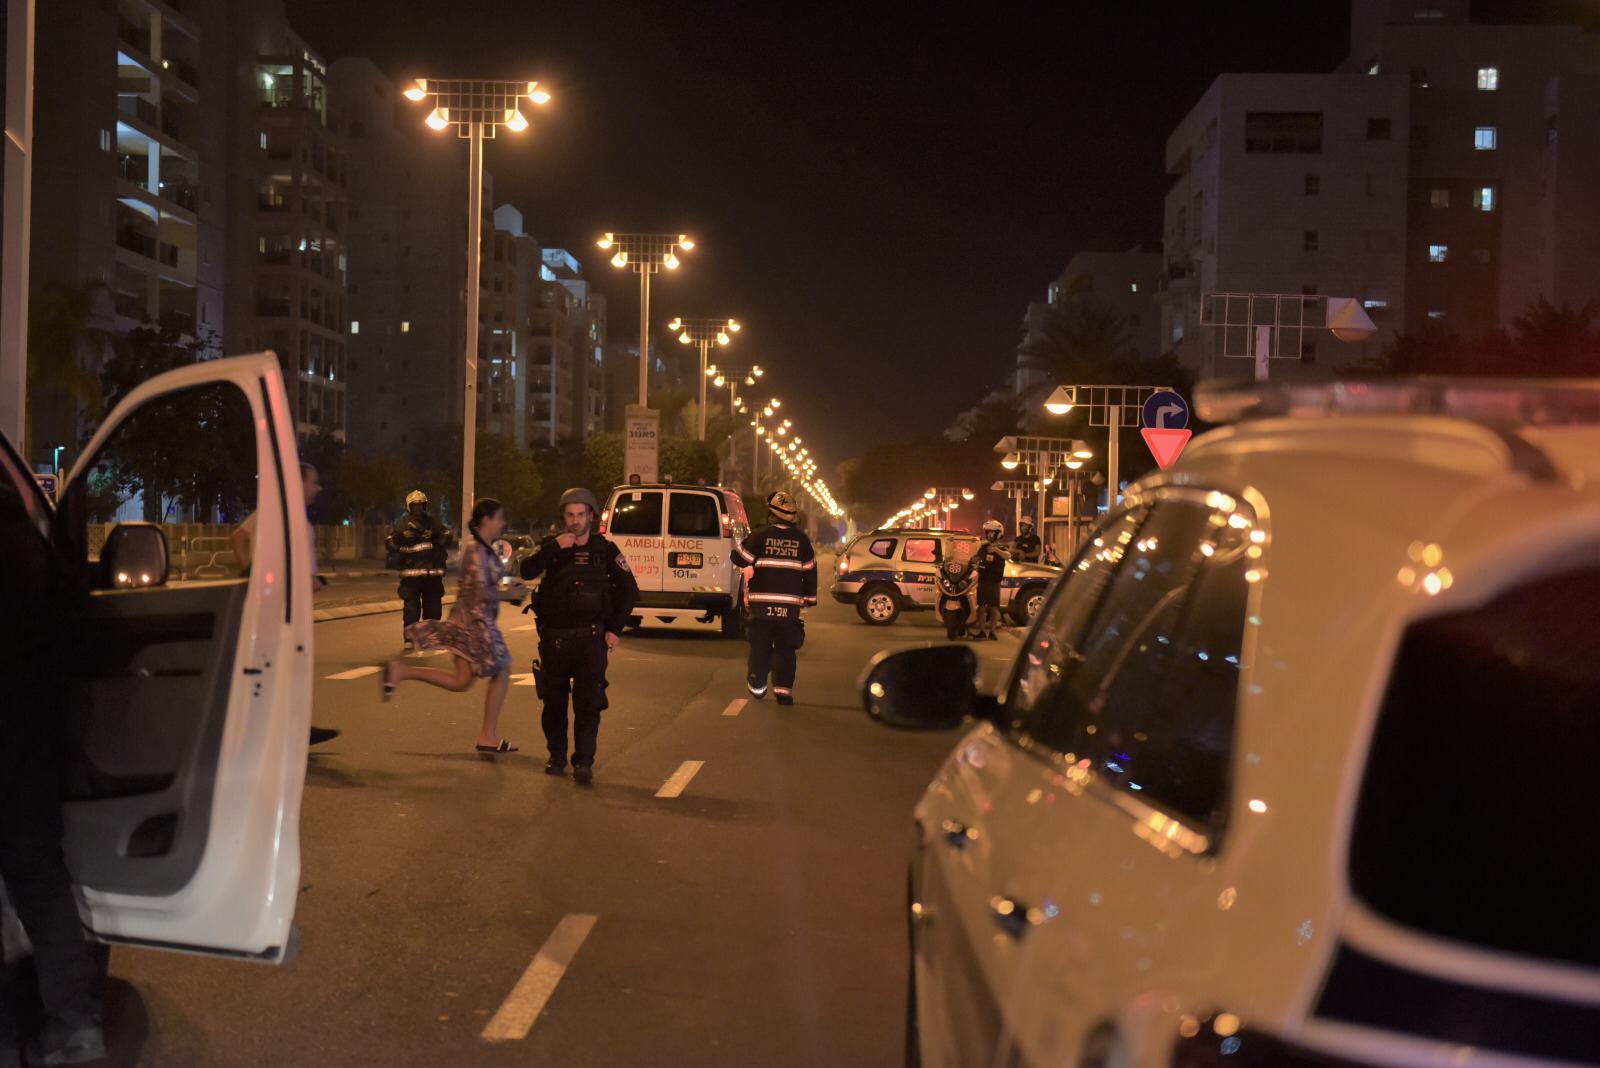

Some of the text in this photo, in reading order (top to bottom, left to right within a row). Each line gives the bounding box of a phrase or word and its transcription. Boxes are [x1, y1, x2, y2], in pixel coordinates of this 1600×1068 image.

[625, 539, 703, 549] AMBULANCE
[766, 538, 799, 549] כבאות
[766, 547, 797, 557] והצלה
[672, 569, 690, 579] 101
